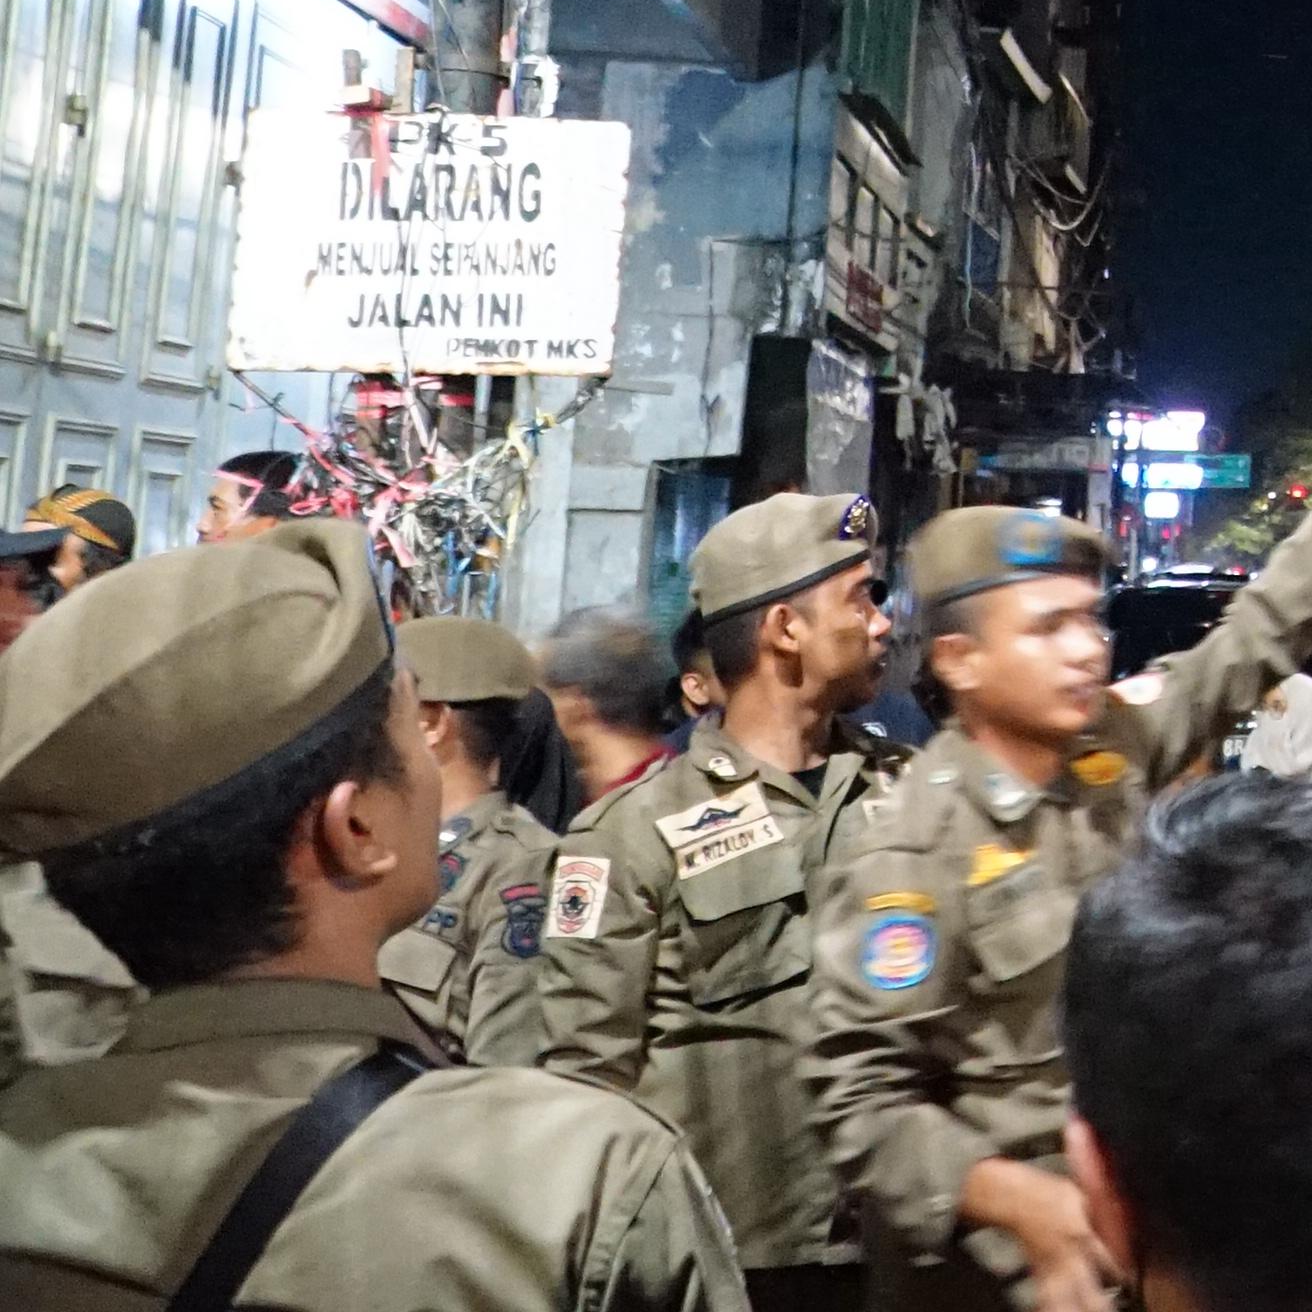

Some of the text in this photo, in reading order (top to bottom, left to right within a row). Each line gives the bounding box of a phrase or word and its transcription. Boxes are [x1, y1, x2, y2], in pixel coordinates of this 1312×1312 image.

[340, 162, 541, 222] DILARANG
[317, 241, 556, 277] MENJUAL SEPANJANG
[348, 293, 523, 327] JALAN INI
[447, 338, 598, 359] PEMKOT MKS
